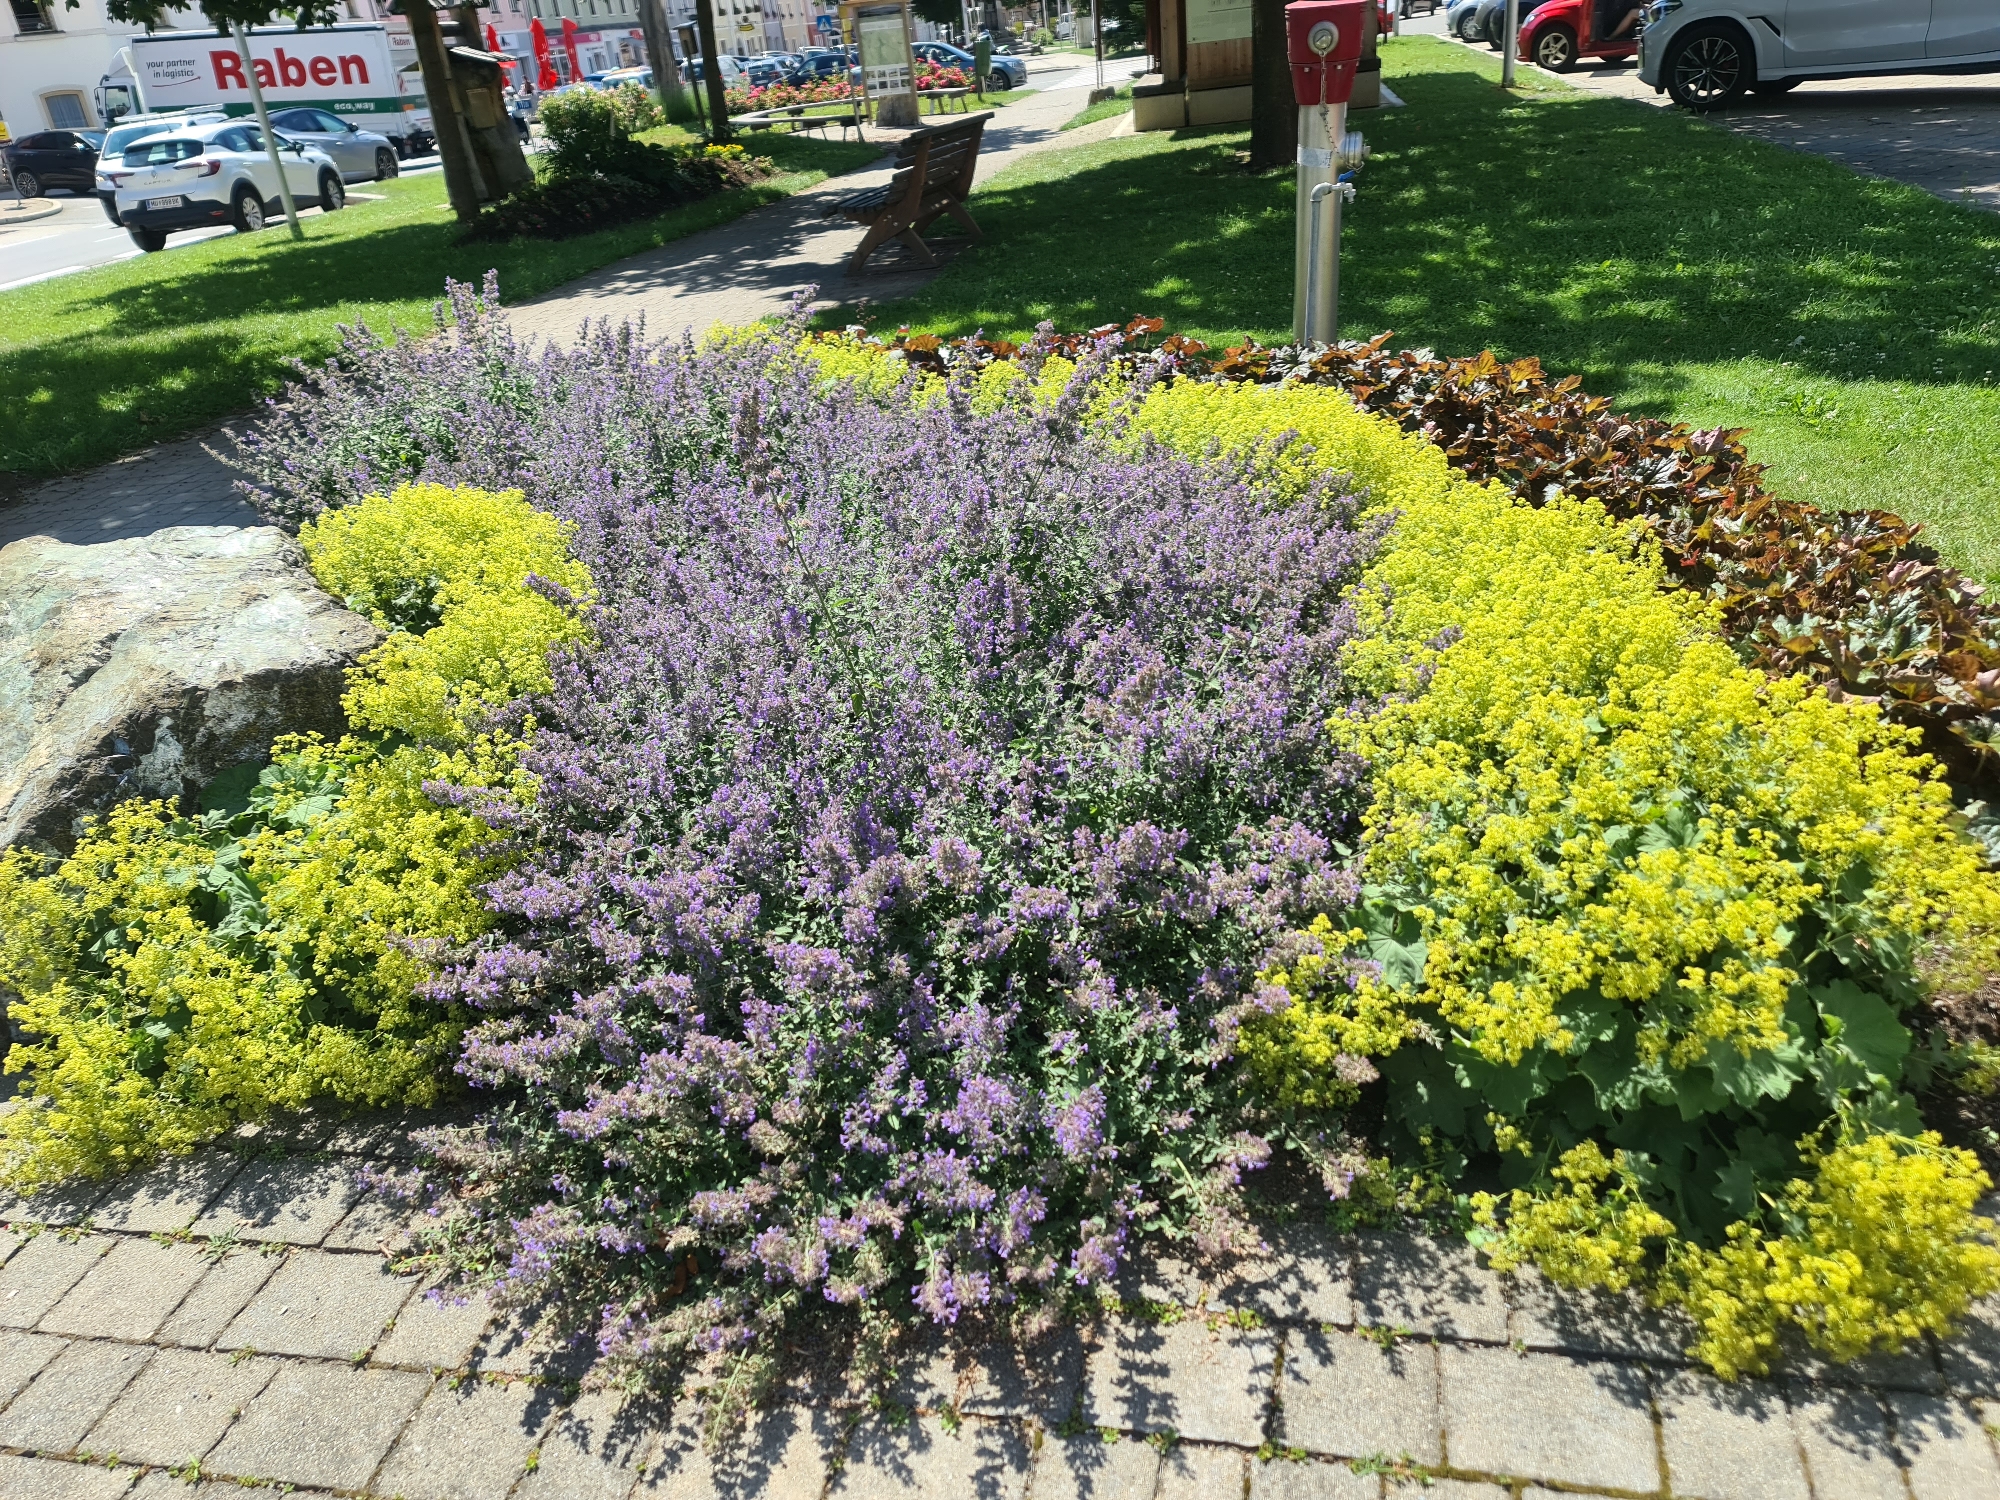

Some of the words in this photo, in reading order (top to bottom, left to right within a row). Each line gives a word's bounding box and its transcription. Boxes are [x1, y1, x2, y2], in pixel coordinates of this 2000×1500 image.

[146, 61, 164, 70] your
[166, 59, 195, 69] partner
[208, 47, 371, 91] Raben
[153, 70, 161, 79] in
[162, 68, 195, 80] logistics
